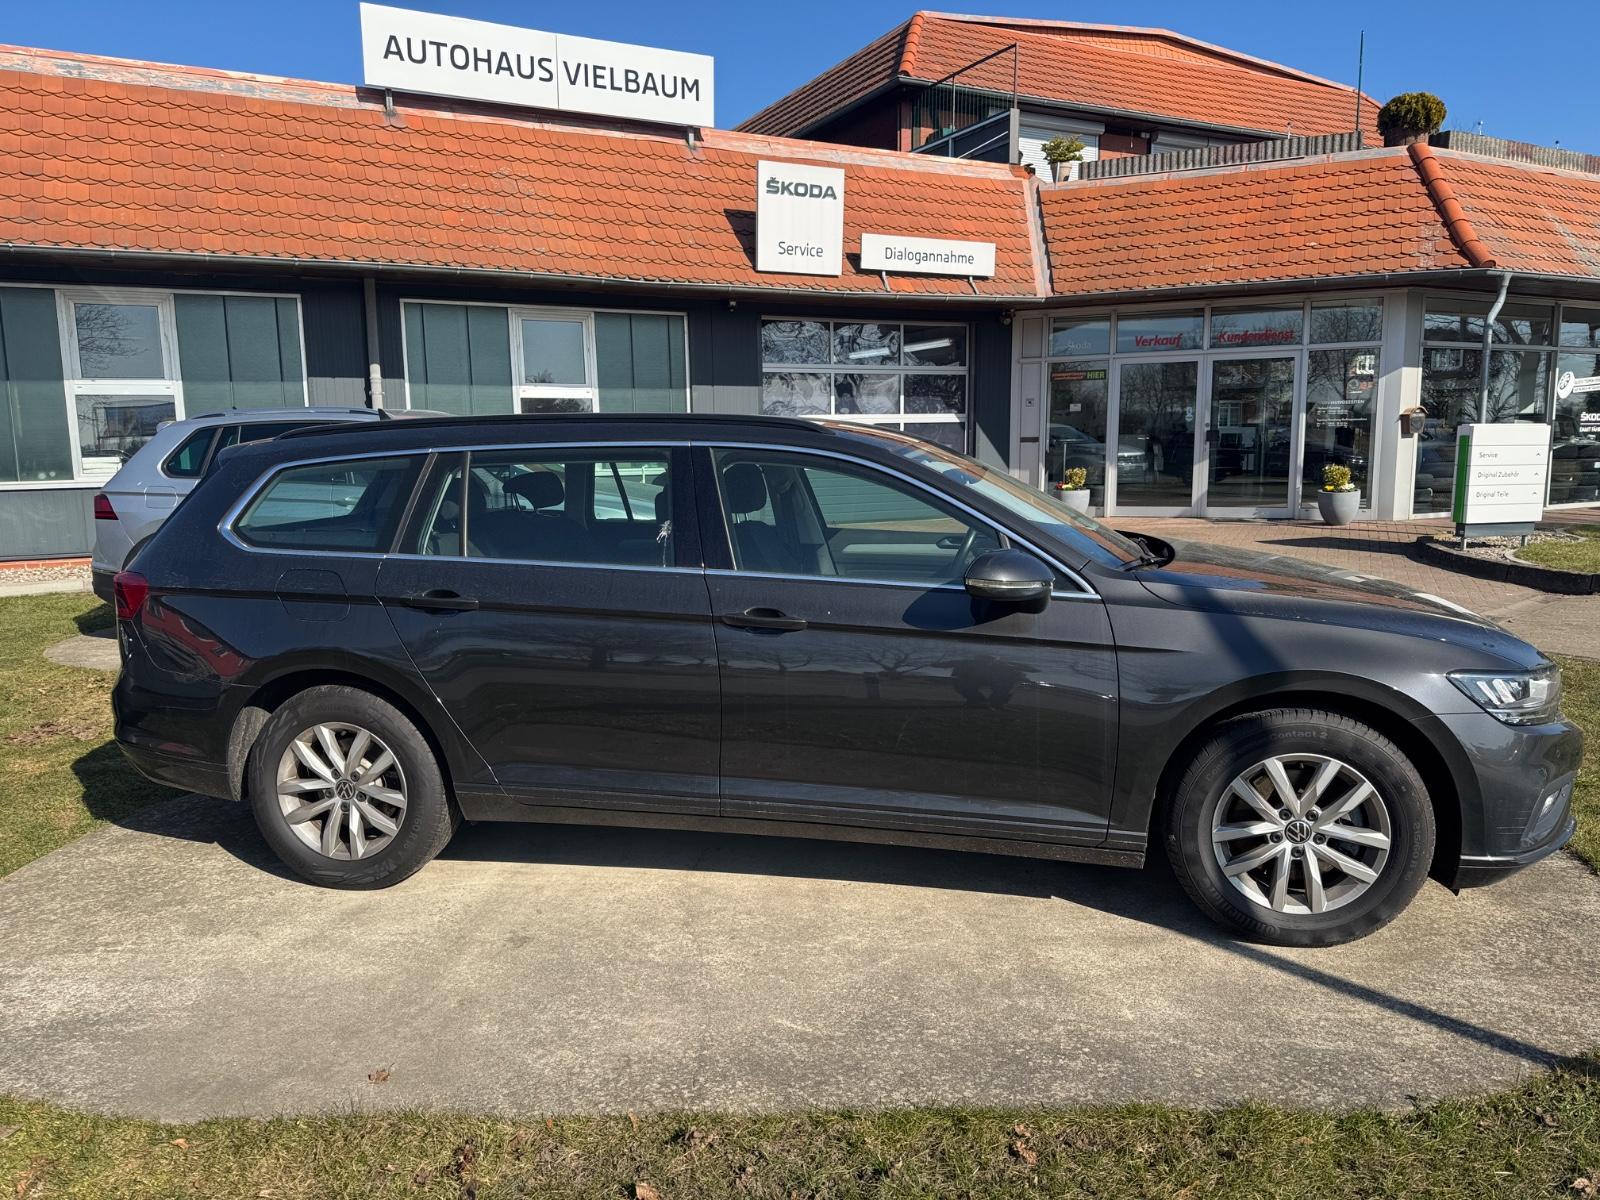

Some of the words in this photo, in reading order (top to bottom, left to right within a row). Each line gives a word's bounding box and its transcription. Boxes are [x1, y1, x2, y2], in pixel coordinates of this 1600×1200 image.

[383, 34, 554, 83] AUTOHAUS
[562, 60, 700, 101] VIELBAUM
[765, 177, 837, 200] ŠKODA
[777, 241, 824, 258] Service
[884, 247, 975, 265] Dialogannahme
[1135, 333, 1183, 348] Verkauf
[1217, 329, 1295, 343] Kundendienst
[1087, 371, 1105, 379] HIER
[1580, 411, 1600, 421] ŠKOD
[1479, 451, 1498, 459] Service
[1477, 471, 1498, 479] Original
[1498, 470, 1519, 478] Zubehör
[1475, 491, 1496, 499] Original
